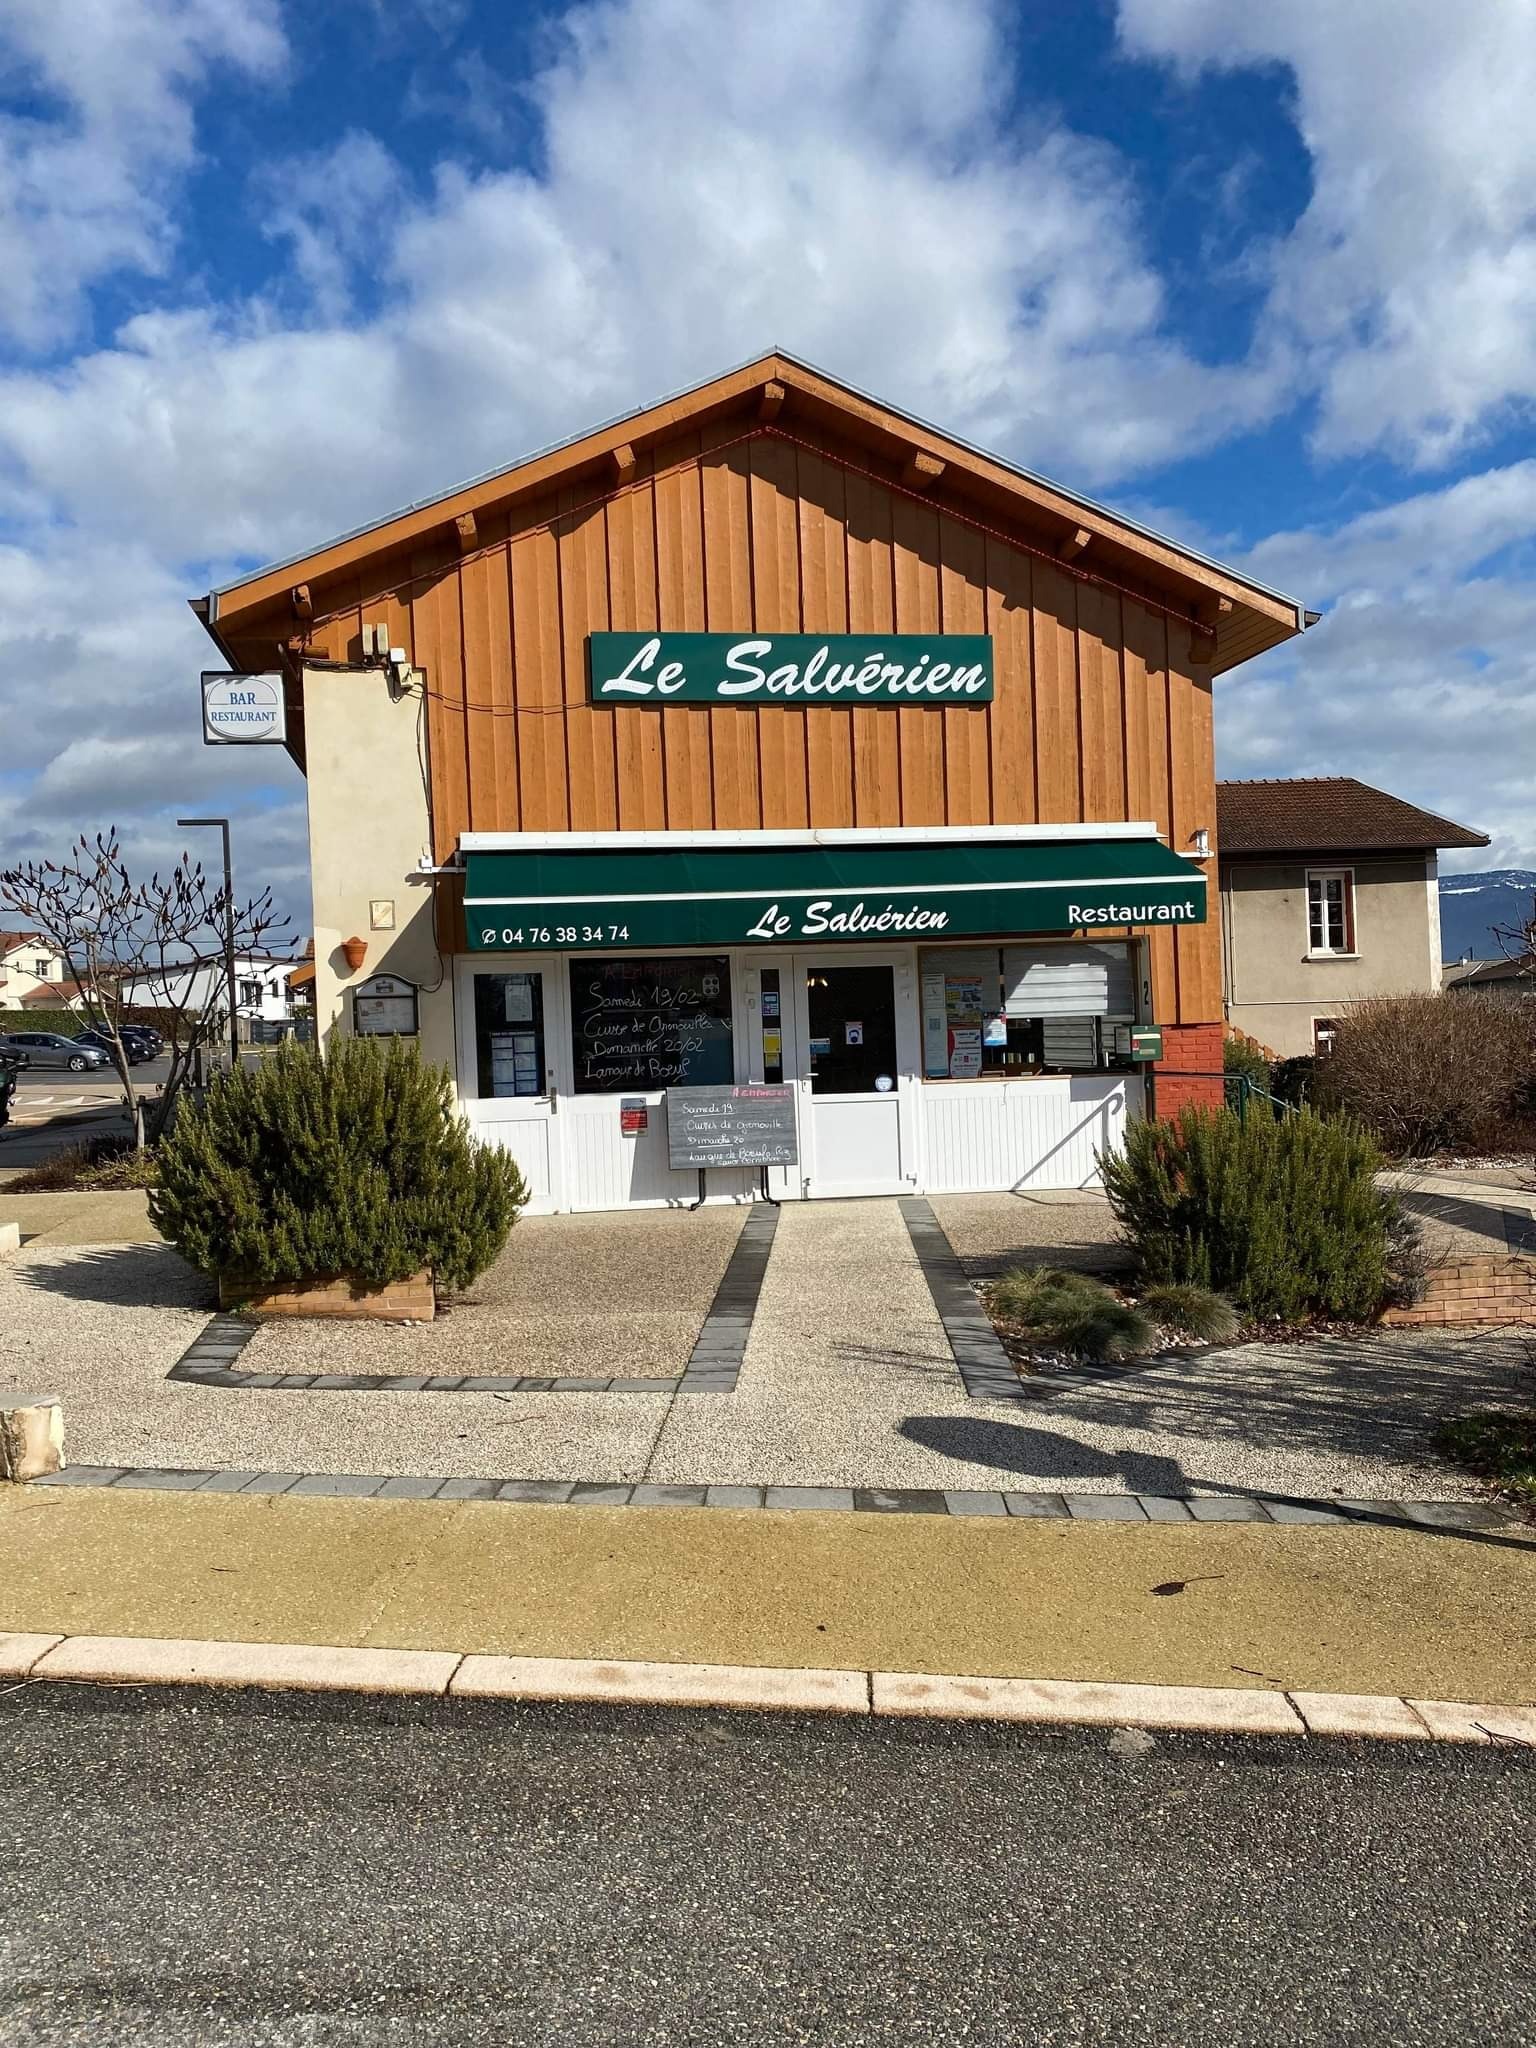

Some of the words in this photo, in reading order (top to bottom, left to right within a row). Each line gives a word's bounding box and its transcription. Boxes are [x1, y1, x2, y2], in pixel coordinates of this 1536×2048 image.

[601, 638, 687, 695] Le
[716, 640, 987, 696] Salvérien
[229, 692, 256, 705] BAR
[211, 711, 277, 722] RESTAURANT
[746, 903, 792, 938] Le
[800, 900, 950, 934] Salvérien
[1067, 900, 1196, 924] Restaurant
[502, 928, 524, 944] 04
[529, 928, 550, 943] 76
[555, 927, 577, 943] 38
[582, 926, 604, 942] 34
[608, 925, 630, 941] 74
[582, 981, 642, 1014] Samedi
[651, 984, 702, 1007] 19/02
[632, 1018, 646, 1032] de
[663, 1036, 705, 1054] 20/02
[634, 1060, 644, 1077] de
[682, 1103, 720, 1114] Samedi
[720, 1120, 731, 1129] de
[733, 1135, 745, 1144] 20
[726, 1147, 736, 1159] de
